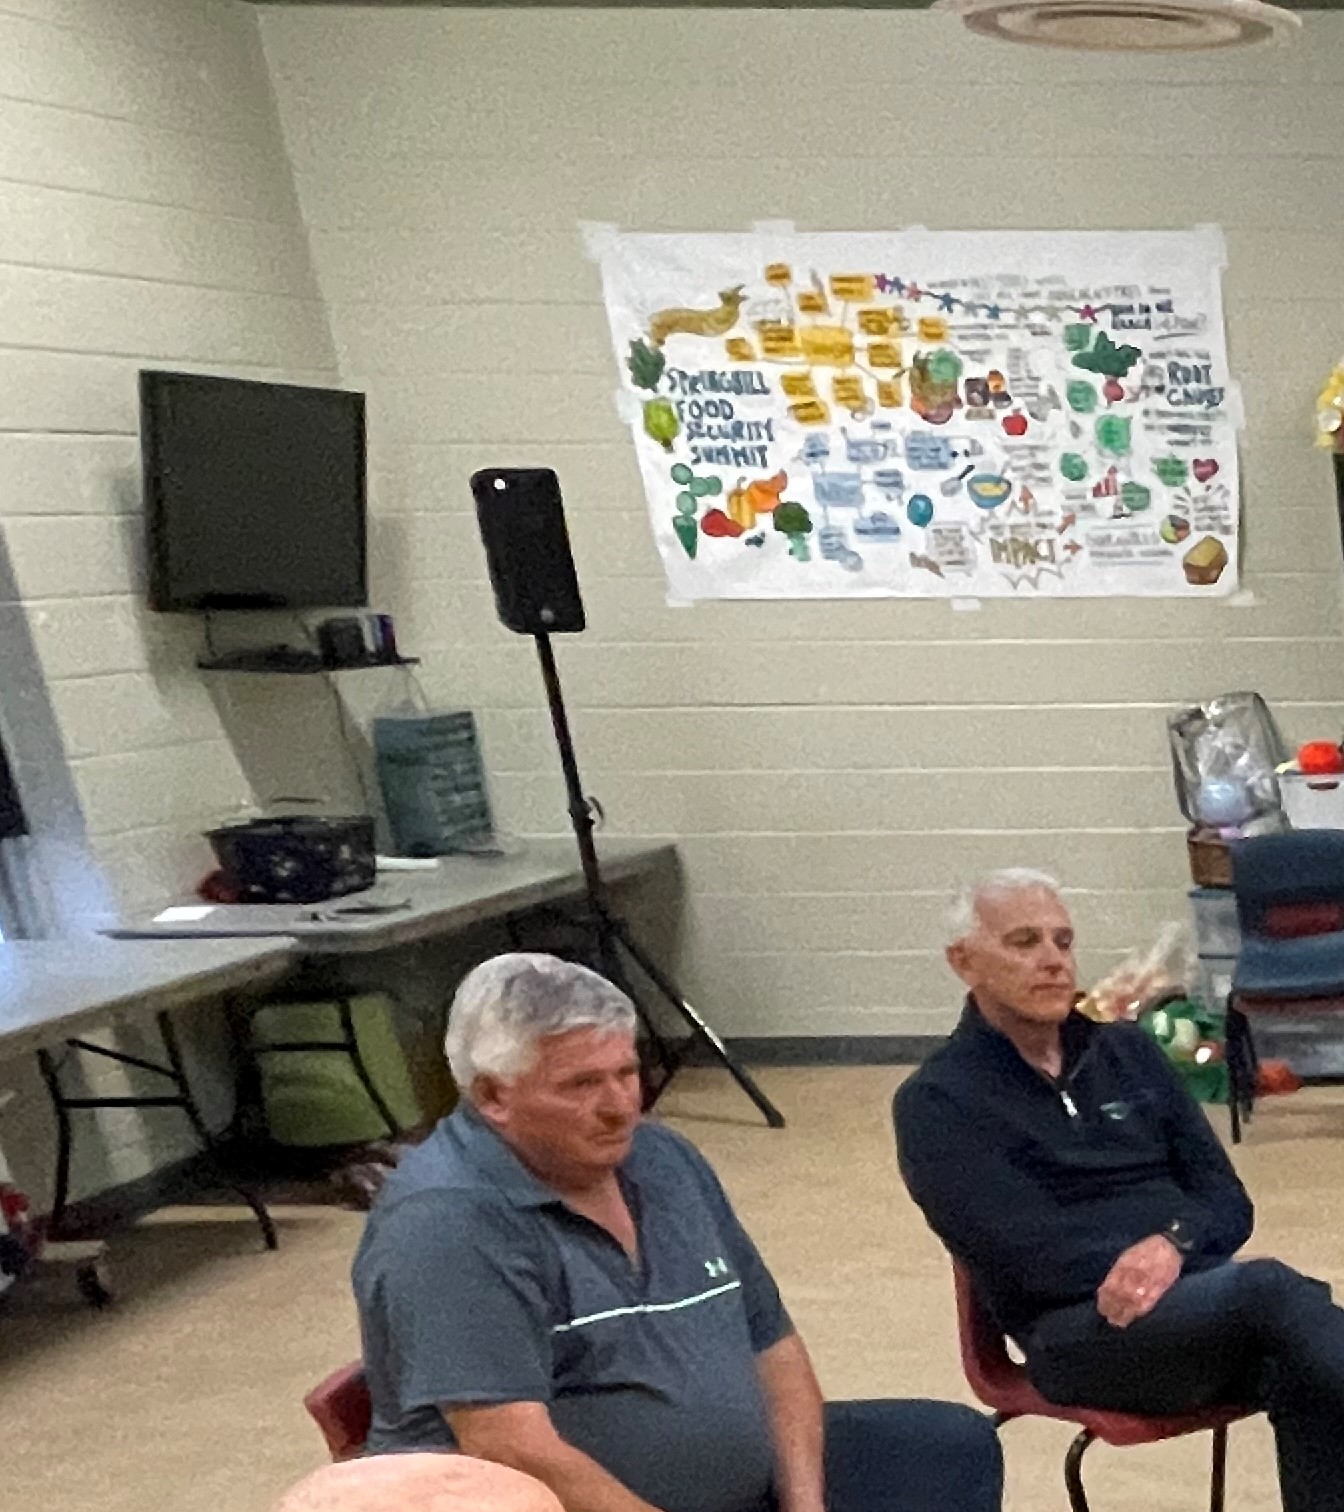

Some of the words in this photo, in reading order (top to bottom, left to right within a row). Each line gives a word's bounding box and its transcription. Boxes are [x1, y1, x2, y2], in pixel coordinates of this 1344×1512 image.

[676, 398, 734, 422] FOOD
[686, 417, 775, 442] SECURITY
[690, 444, 768, 468] SUMMIT
